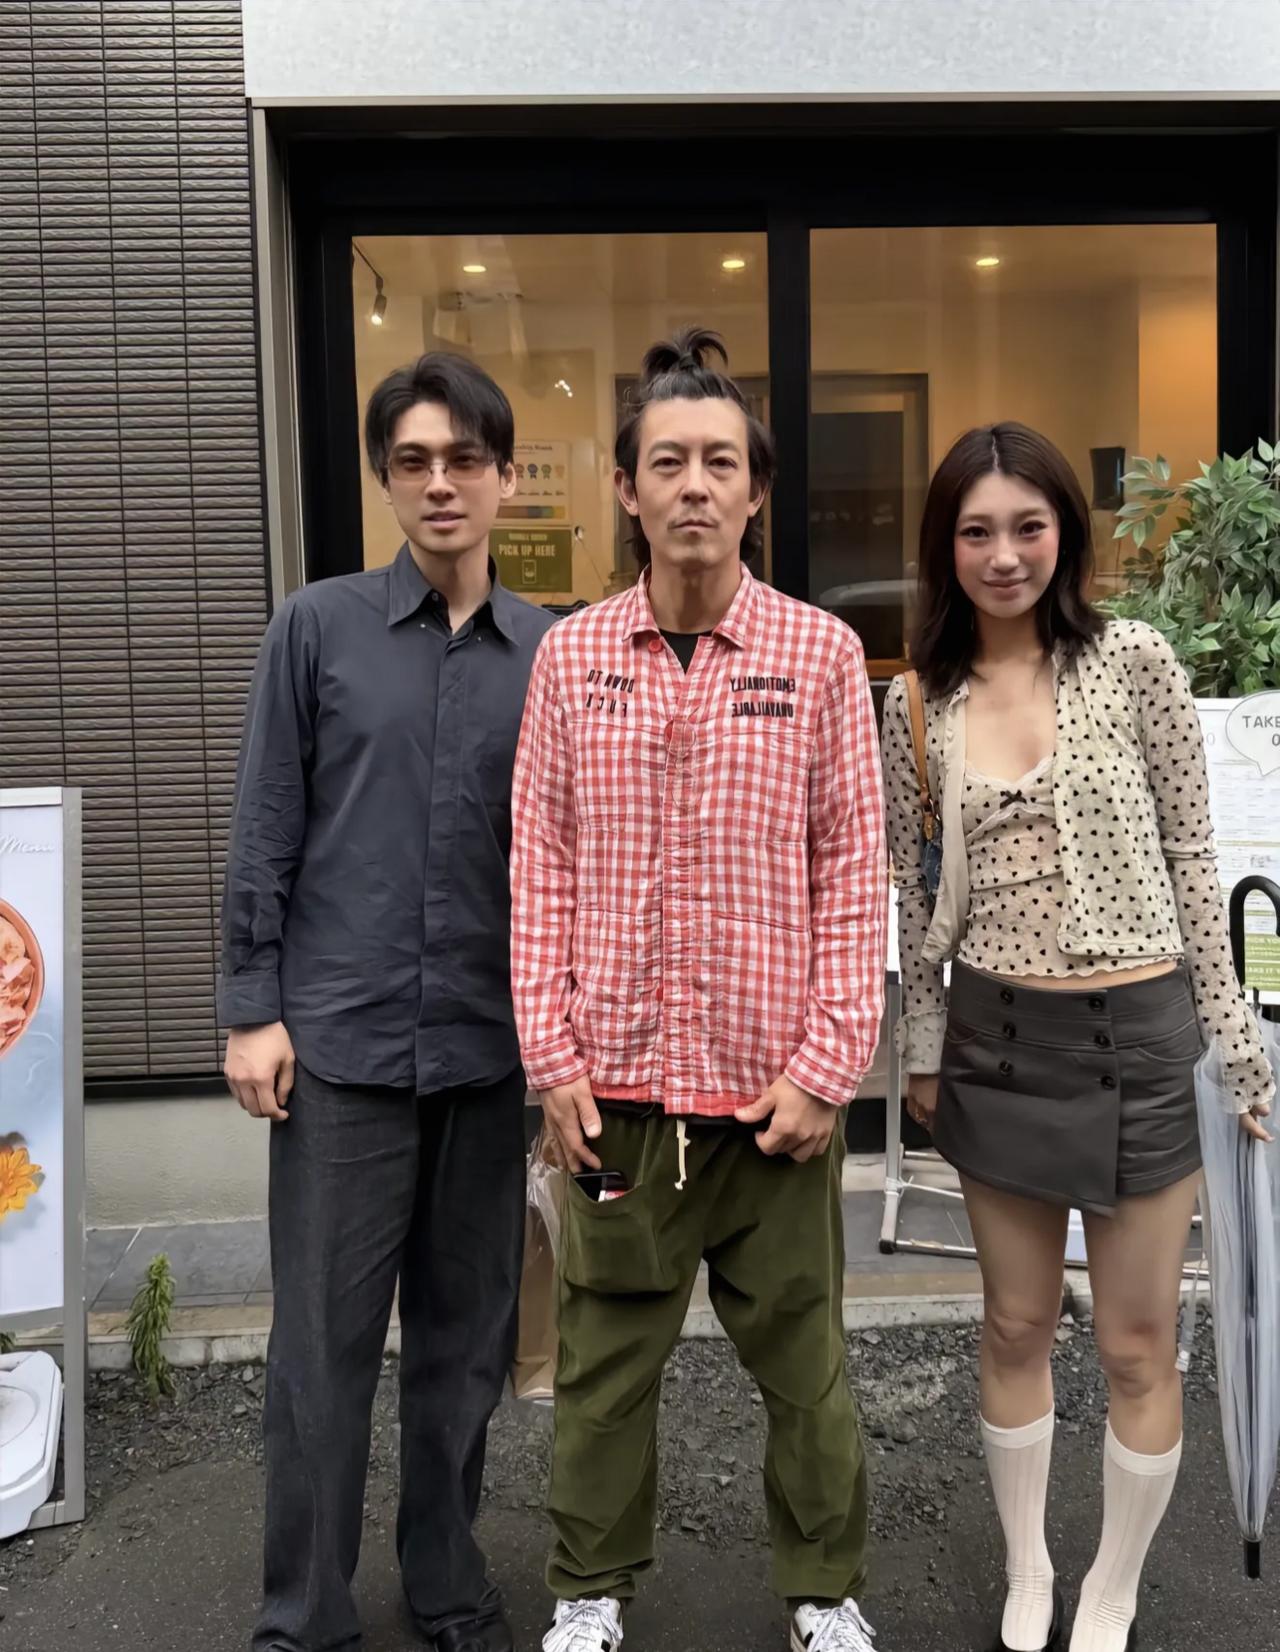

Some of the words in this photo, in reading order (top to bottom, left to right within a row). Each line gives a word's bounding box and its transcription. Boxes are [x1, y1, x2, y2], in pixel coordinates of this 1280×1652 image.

[498, 544, 519, 556] PICK
[521, 544, 533, 556] UP
[535, 544, 556, 557] HERE
[1242, 715, 1280, 728] TAKE
